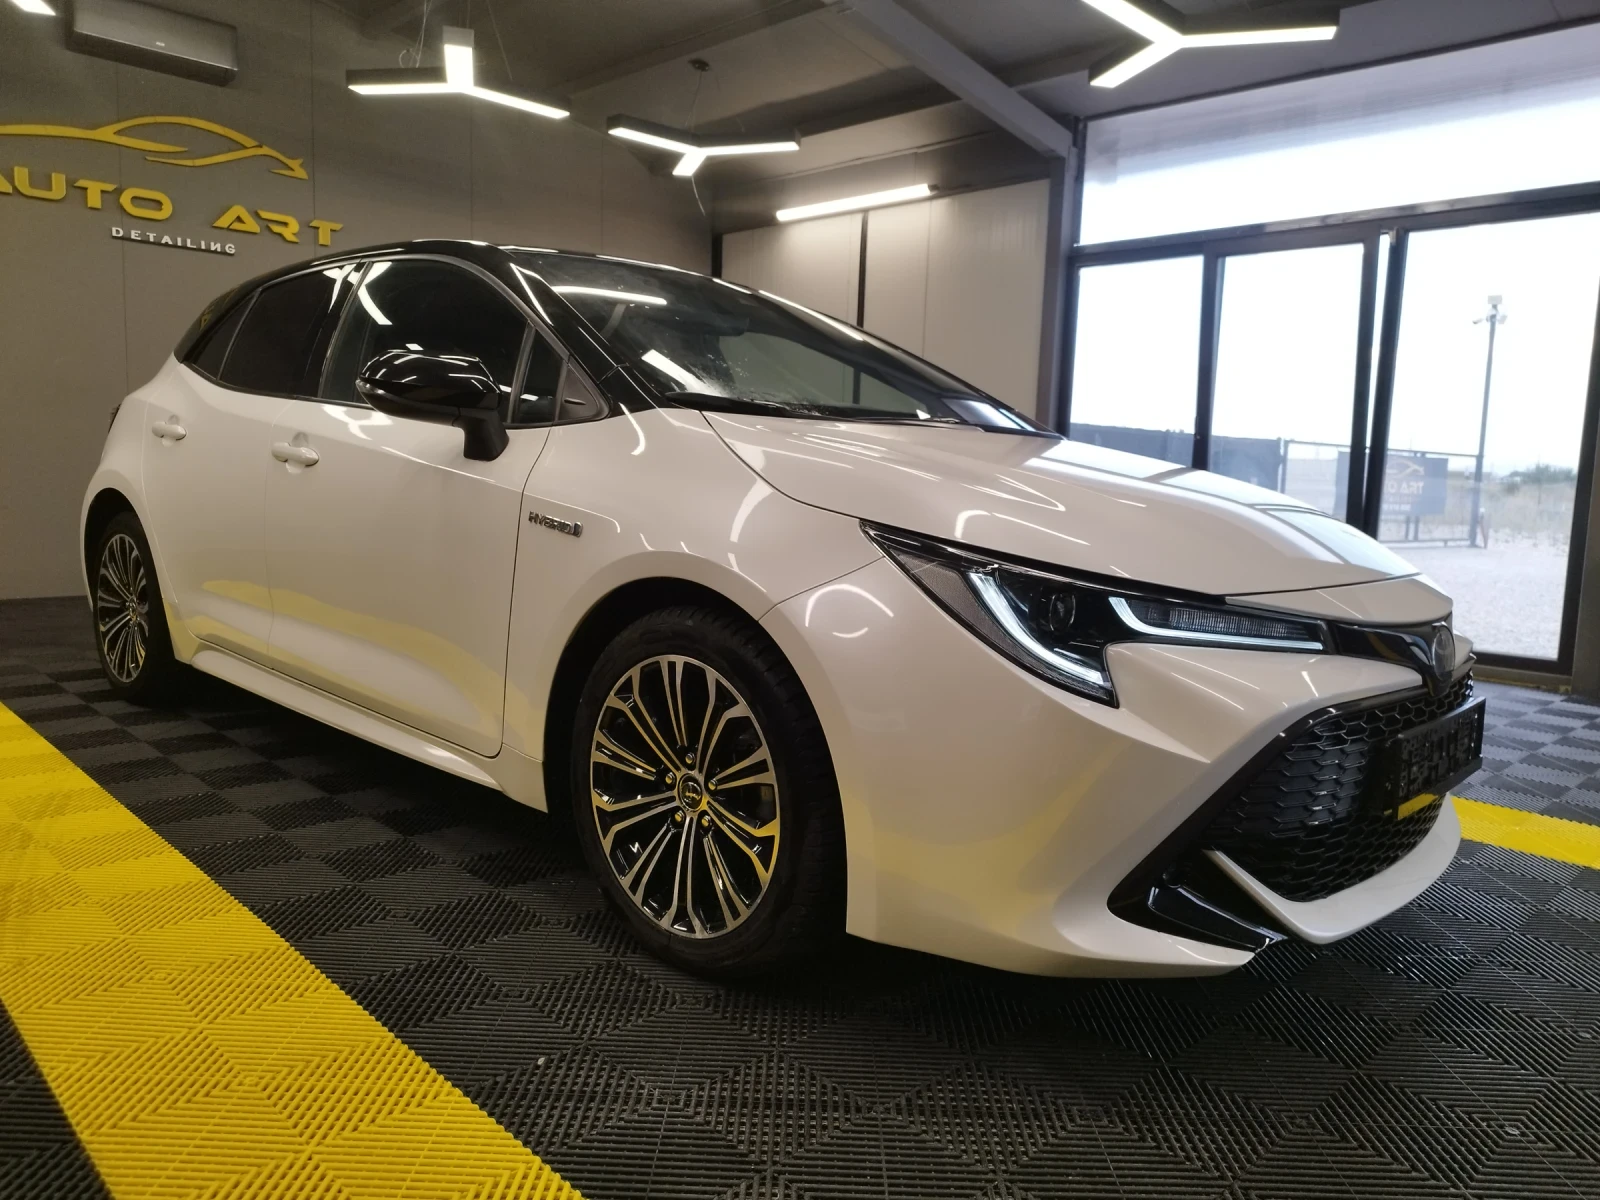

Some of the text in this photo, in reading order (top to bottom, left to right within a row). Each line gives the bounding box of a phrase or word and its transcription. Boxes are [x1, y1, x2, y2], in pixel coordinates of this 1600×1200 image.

[212, 204, 344, 246] ART
[111, 226, 237, 254] DETAILING
[528, 511, 573, 535] HYBRID
